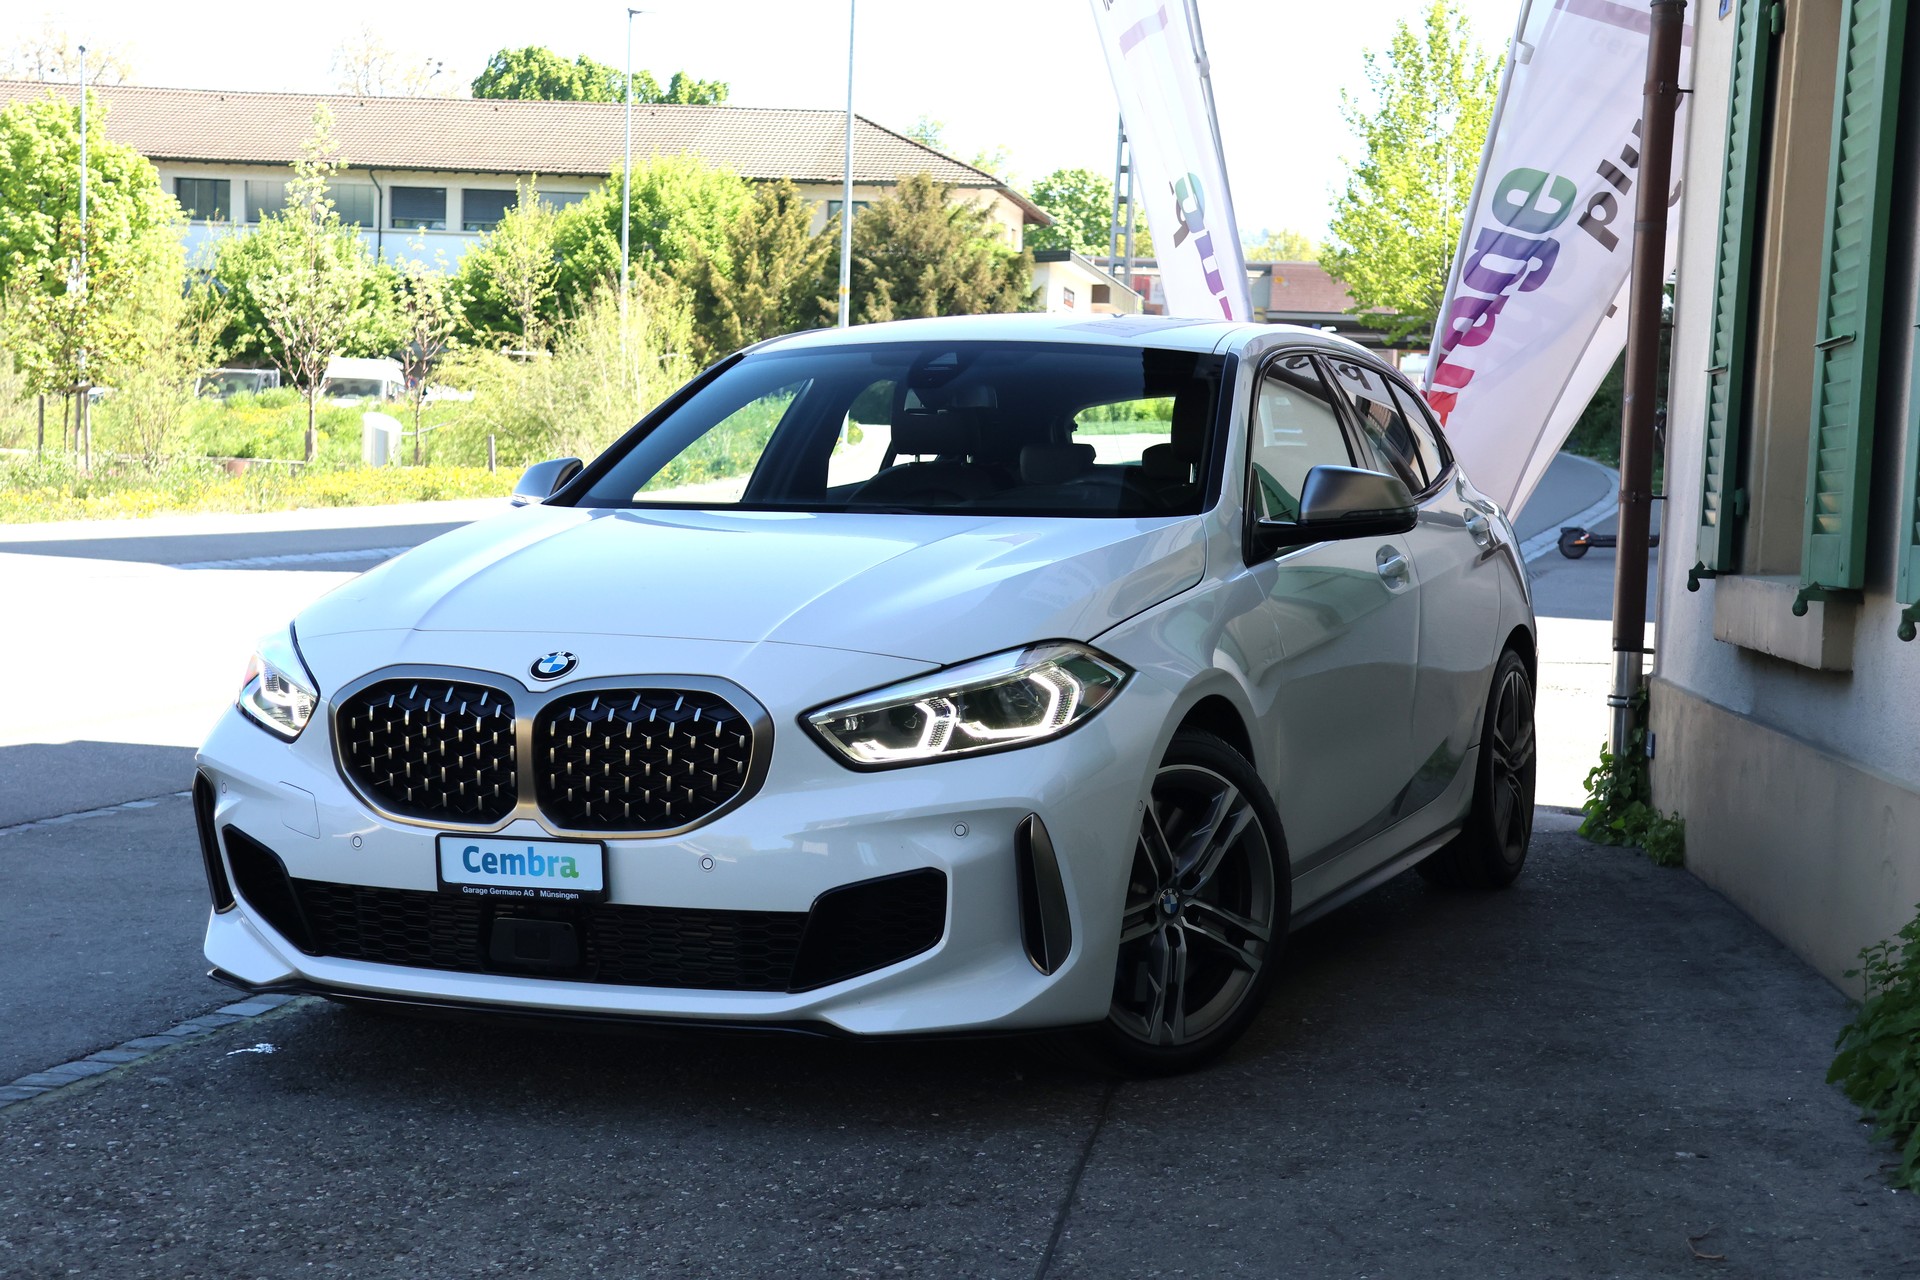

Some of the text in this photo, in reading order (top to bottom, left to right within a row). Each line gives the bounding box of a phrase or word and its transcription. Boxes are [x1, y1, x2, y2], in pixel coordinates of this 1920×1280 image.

[462, 845, 580, 879] Cembra
[462, 886, 579, 900] Garage Germano AG Münsingen
